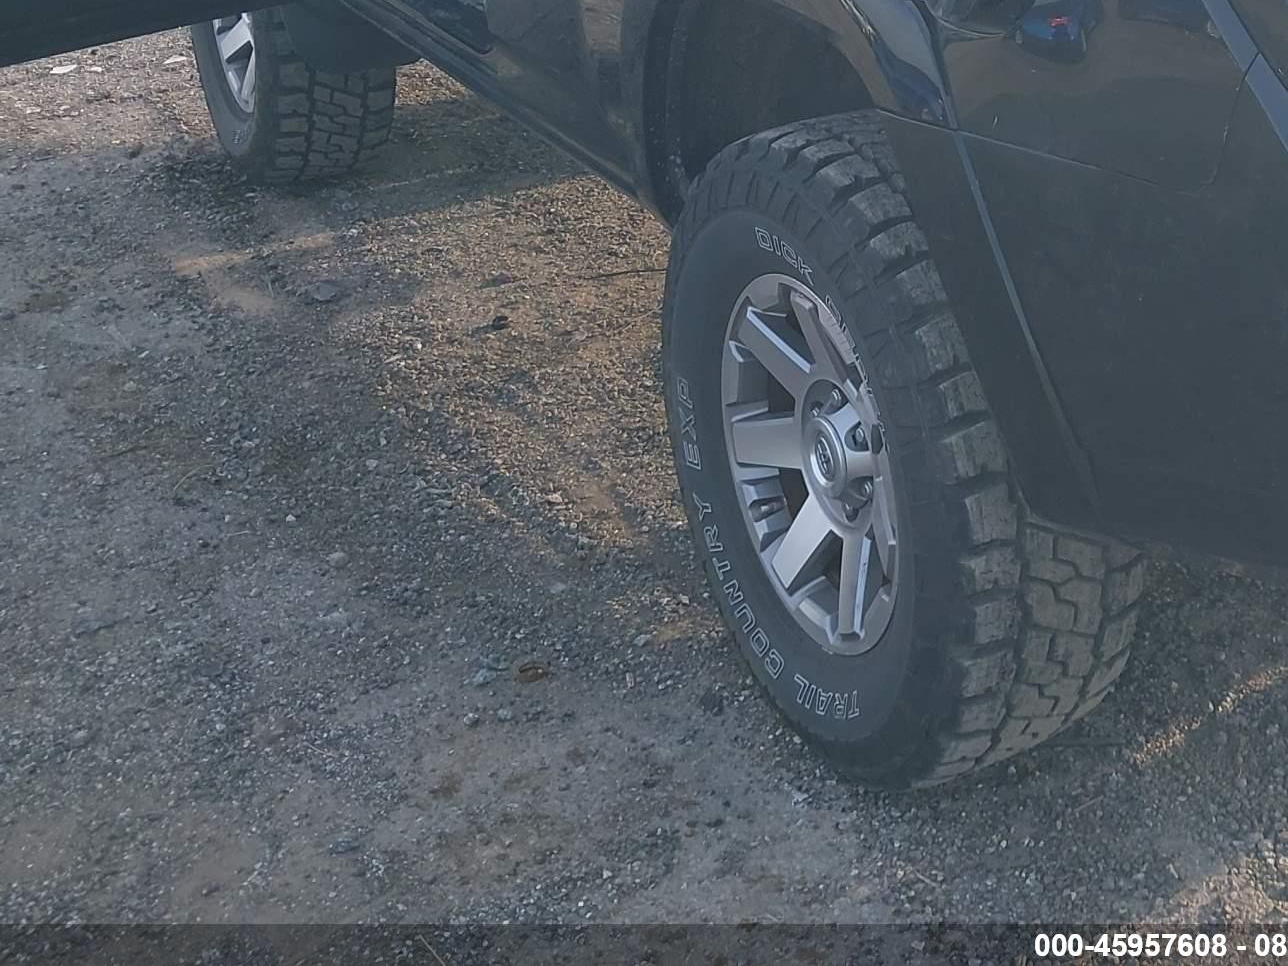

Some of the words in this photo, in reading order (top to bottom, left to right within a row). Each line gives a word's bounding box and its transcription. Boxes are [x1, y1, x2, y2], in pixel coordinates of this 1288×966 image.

[754, 226, 815, 287] DICK
[676, 377, 702, 471] EXP
[692, 491, 786, 680] COUNTRY
[793, 673, 860, 720] TRAIL
